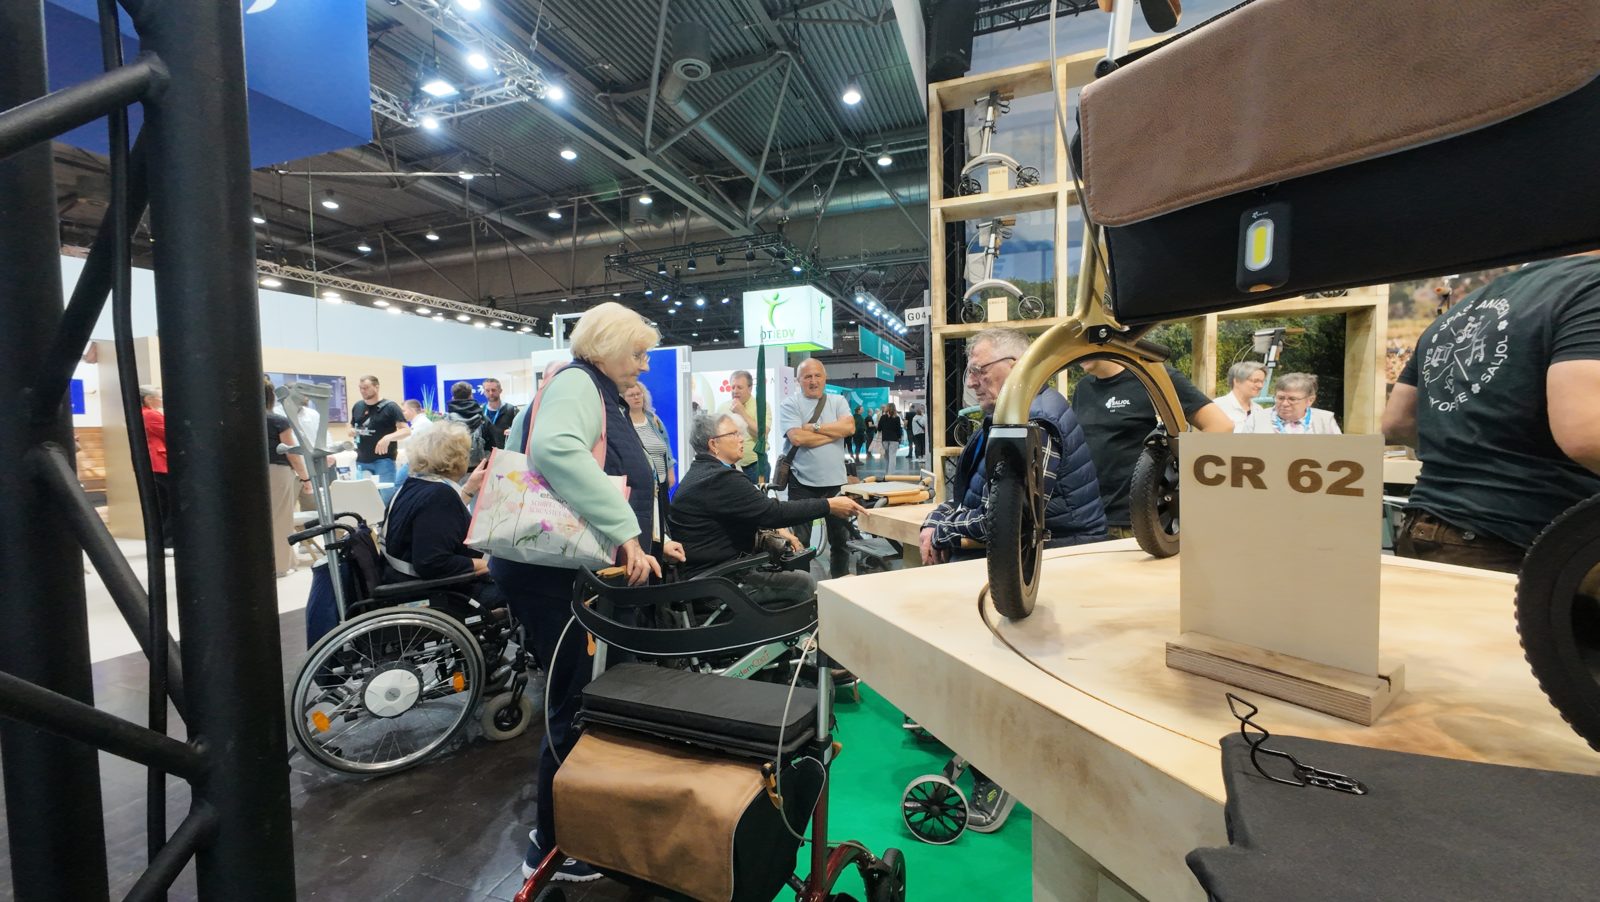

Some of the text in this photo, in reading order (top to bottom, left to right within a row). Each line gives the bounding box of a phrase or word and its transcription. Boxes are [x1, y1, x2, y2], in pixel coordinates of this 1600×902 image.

[907, 311, 927, 321] G04
[1481, 335, 1508, 383] SALJOL
[1193, 454, 1365, 497] CR 62
